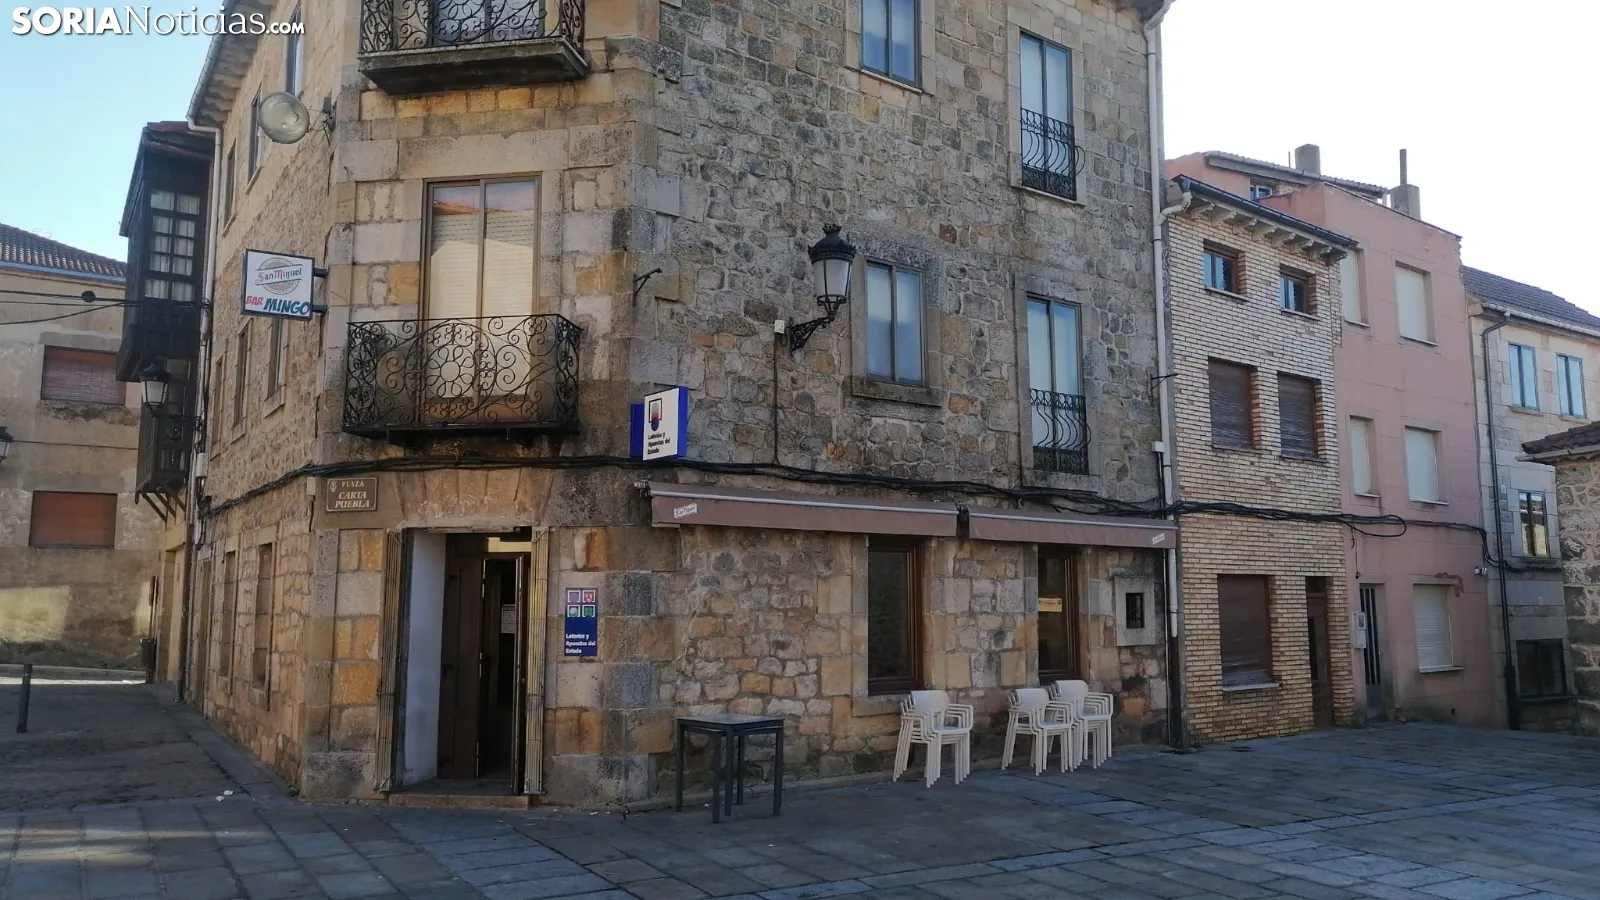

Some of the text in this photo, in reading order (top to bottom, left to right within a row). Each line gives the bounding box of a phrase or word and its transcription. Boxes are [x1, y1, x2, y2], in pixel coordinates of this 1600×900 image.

[246, 295, 311, 315] BAR MINGO
[341, 480, 364, 488] PLAZA
[338, 491, 367, 500] CARTA
[334, 500, 370, 509] PUEBLA
